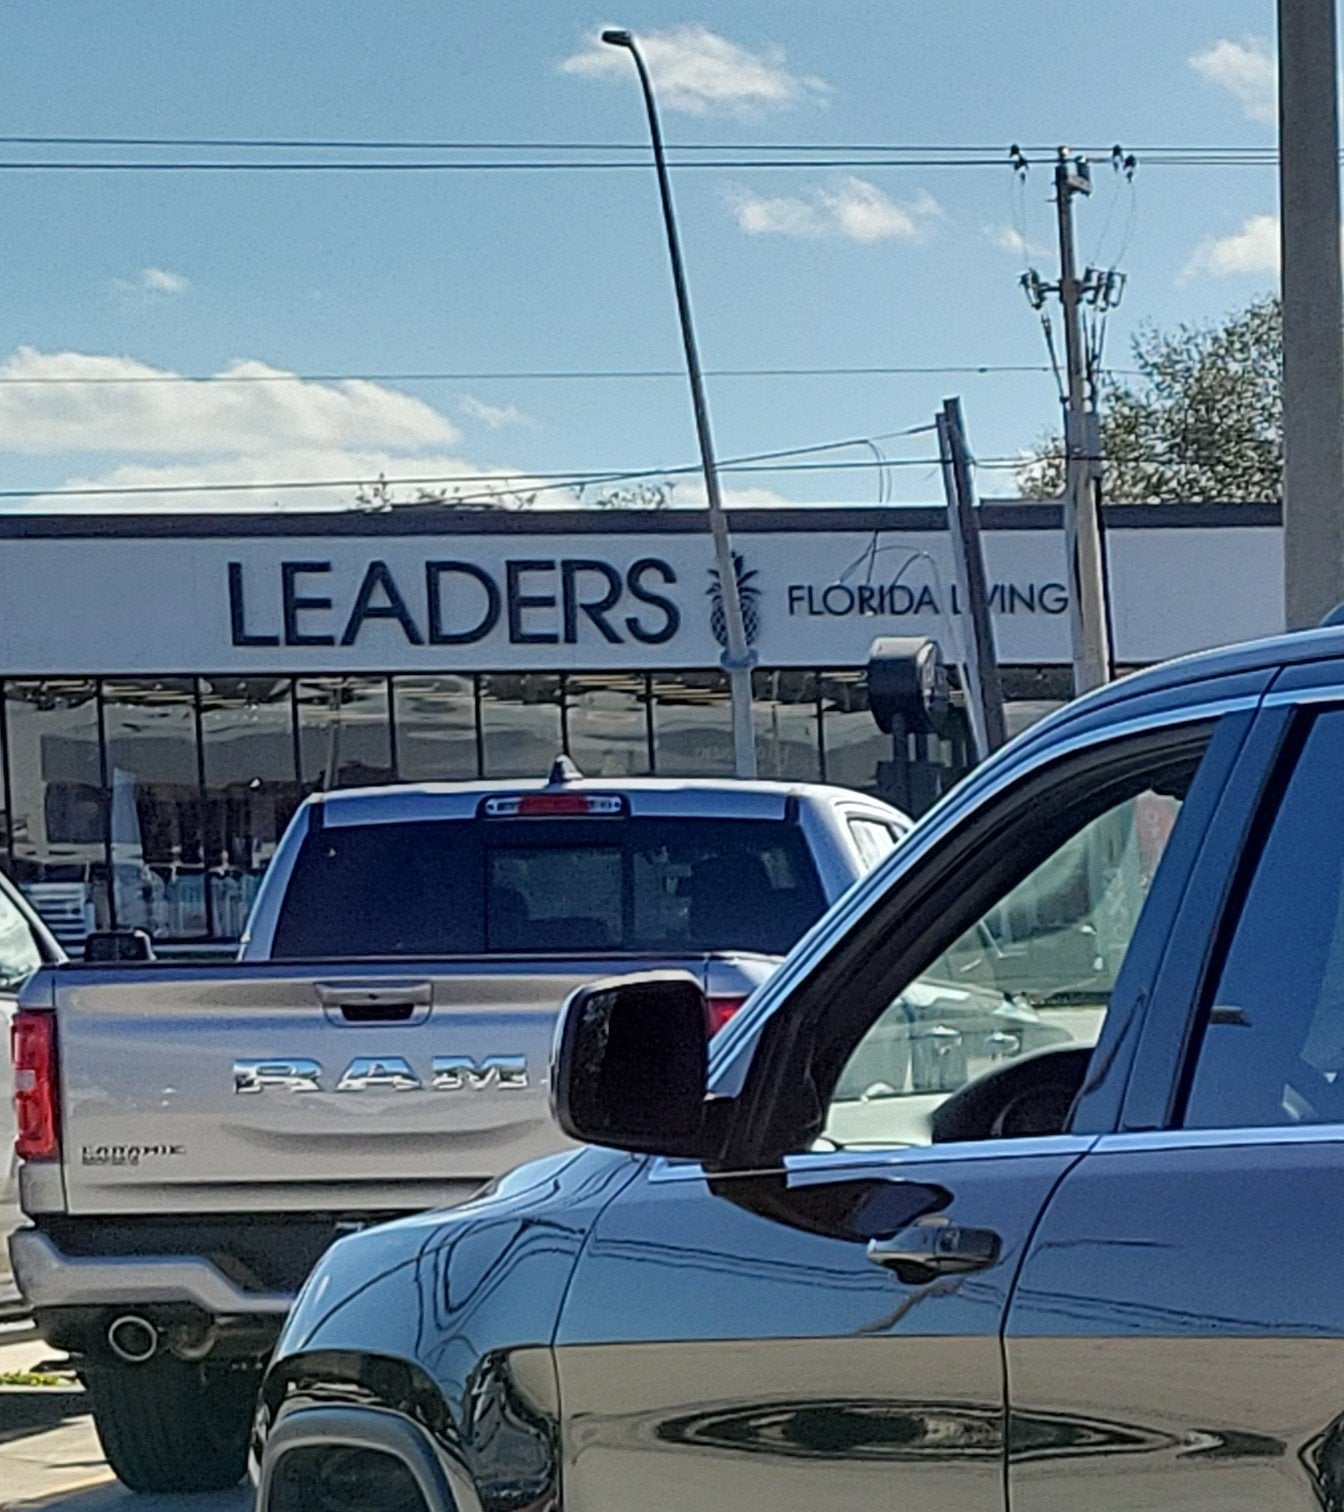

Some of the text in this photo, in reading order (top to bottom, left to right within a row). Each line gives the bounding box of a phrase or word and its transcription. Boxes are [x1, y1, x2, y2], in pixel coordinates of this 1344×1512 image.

[227, 557, 681, 647] LEADERS
[787, 582, 1069, 616] FLORIDA LVING
[233, 1054, 528, 1095] RAM
